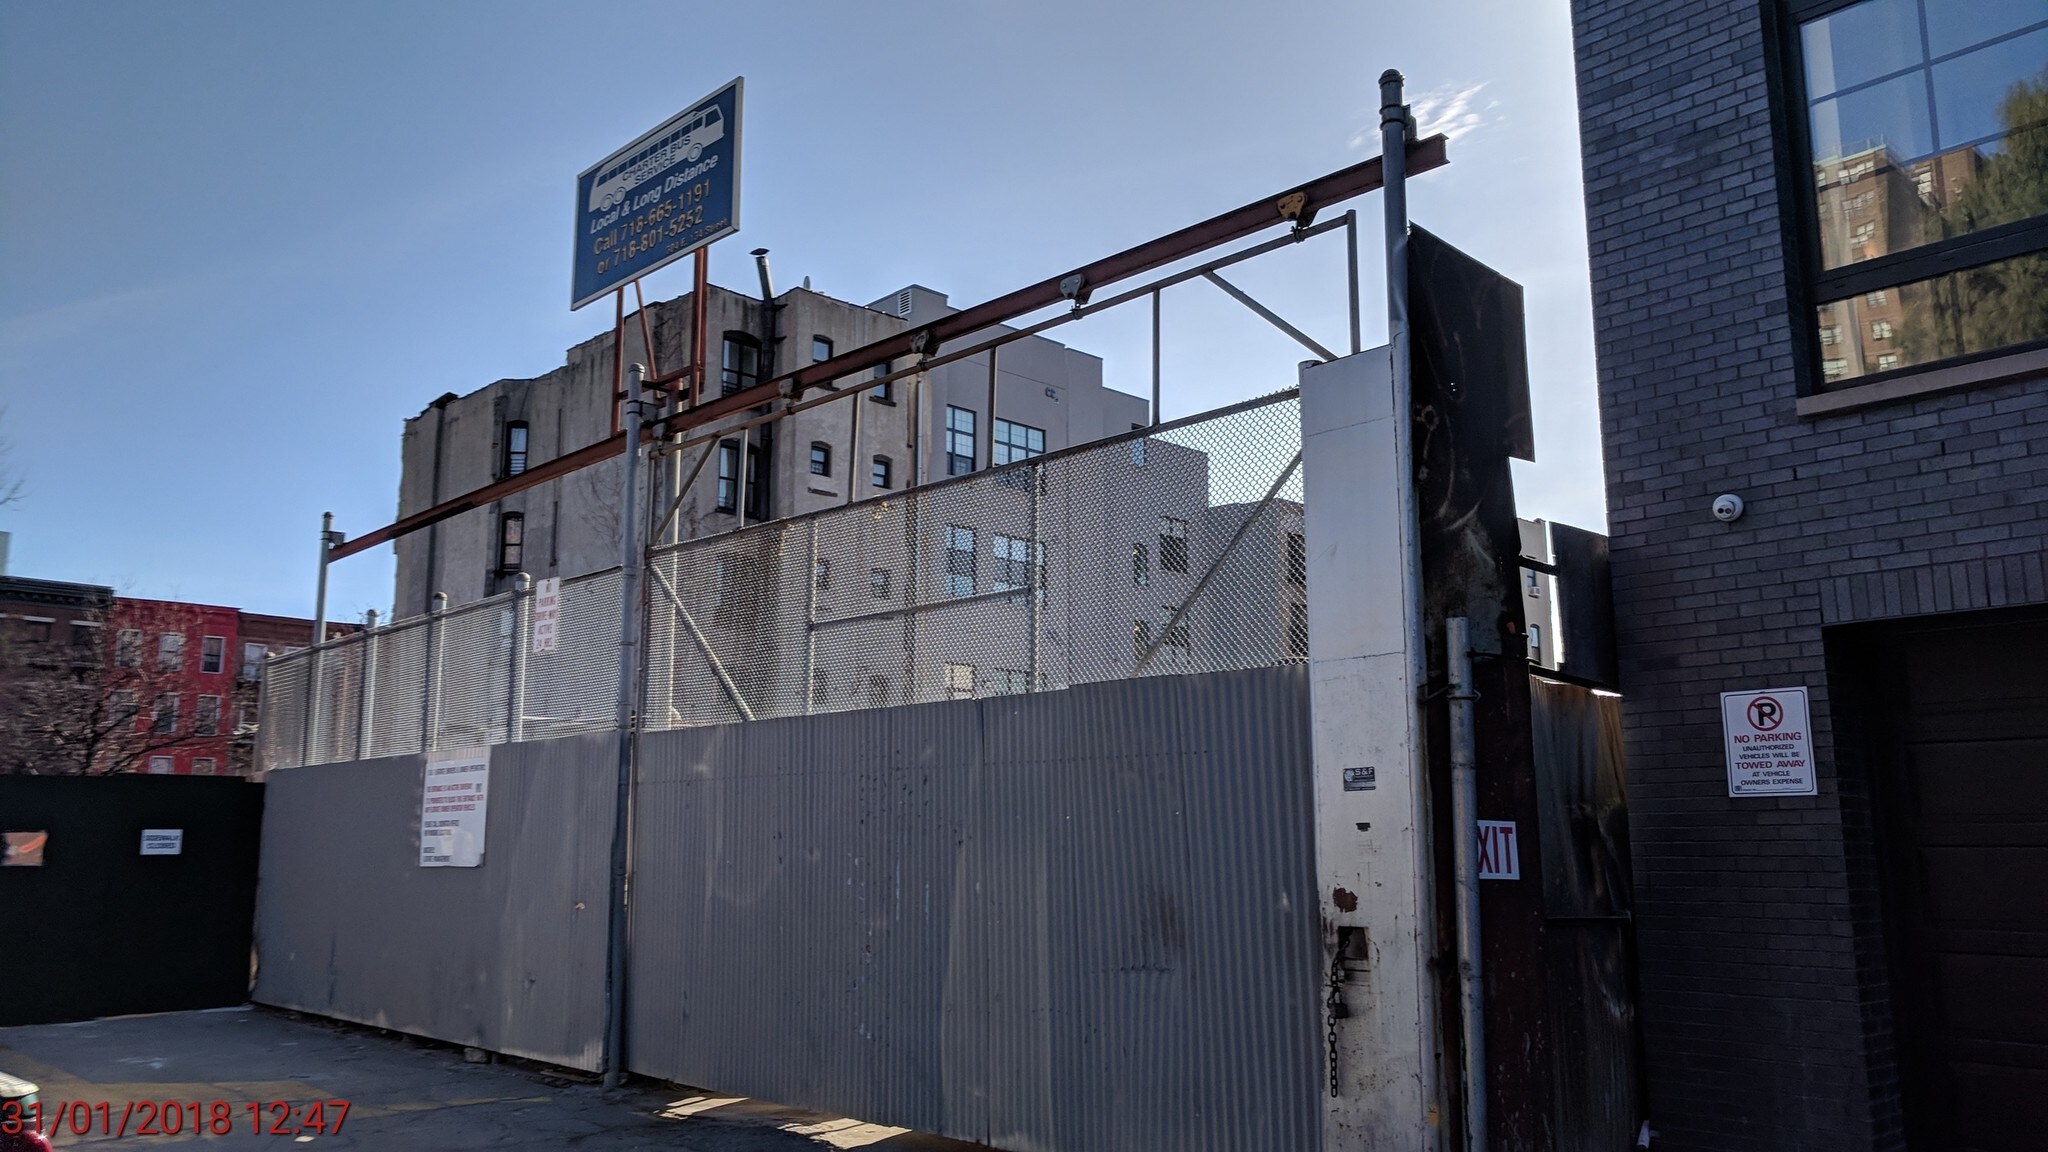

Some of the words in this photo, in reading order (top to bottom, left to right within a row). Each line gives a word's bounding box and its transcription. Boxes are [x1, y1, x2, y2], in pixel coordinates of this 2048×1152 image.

[622, 149, 667, 181] CHARTER
[670, 135, 691, 154] BUS
[635, 153, 676, 184] SERVICE
[590, 205, 620, 234] Local
[621, 201, 631, 217] &
[632, 185, 662, 211] Long
[664, 155, 719, 193] Distance
[594, 229, 618, 255] Call
[621, 179, 711, 240] 718-665-1191
[597, 258, 610, 274] or
[613, 205, 703, 266] 718-801-5252
[538, 595, 557, 607] PARKING
[1734, 735, 1750, 744] NO
[1754, 732, 1802, 742] PARKING
[1742, 744, 1795, 752] UNAUTHORIZED
[1735, 761, 1773, 770] TOWED
[1776, 760, 1806, 768] AWAY
[1477, 826, 1513, 874] XIT
